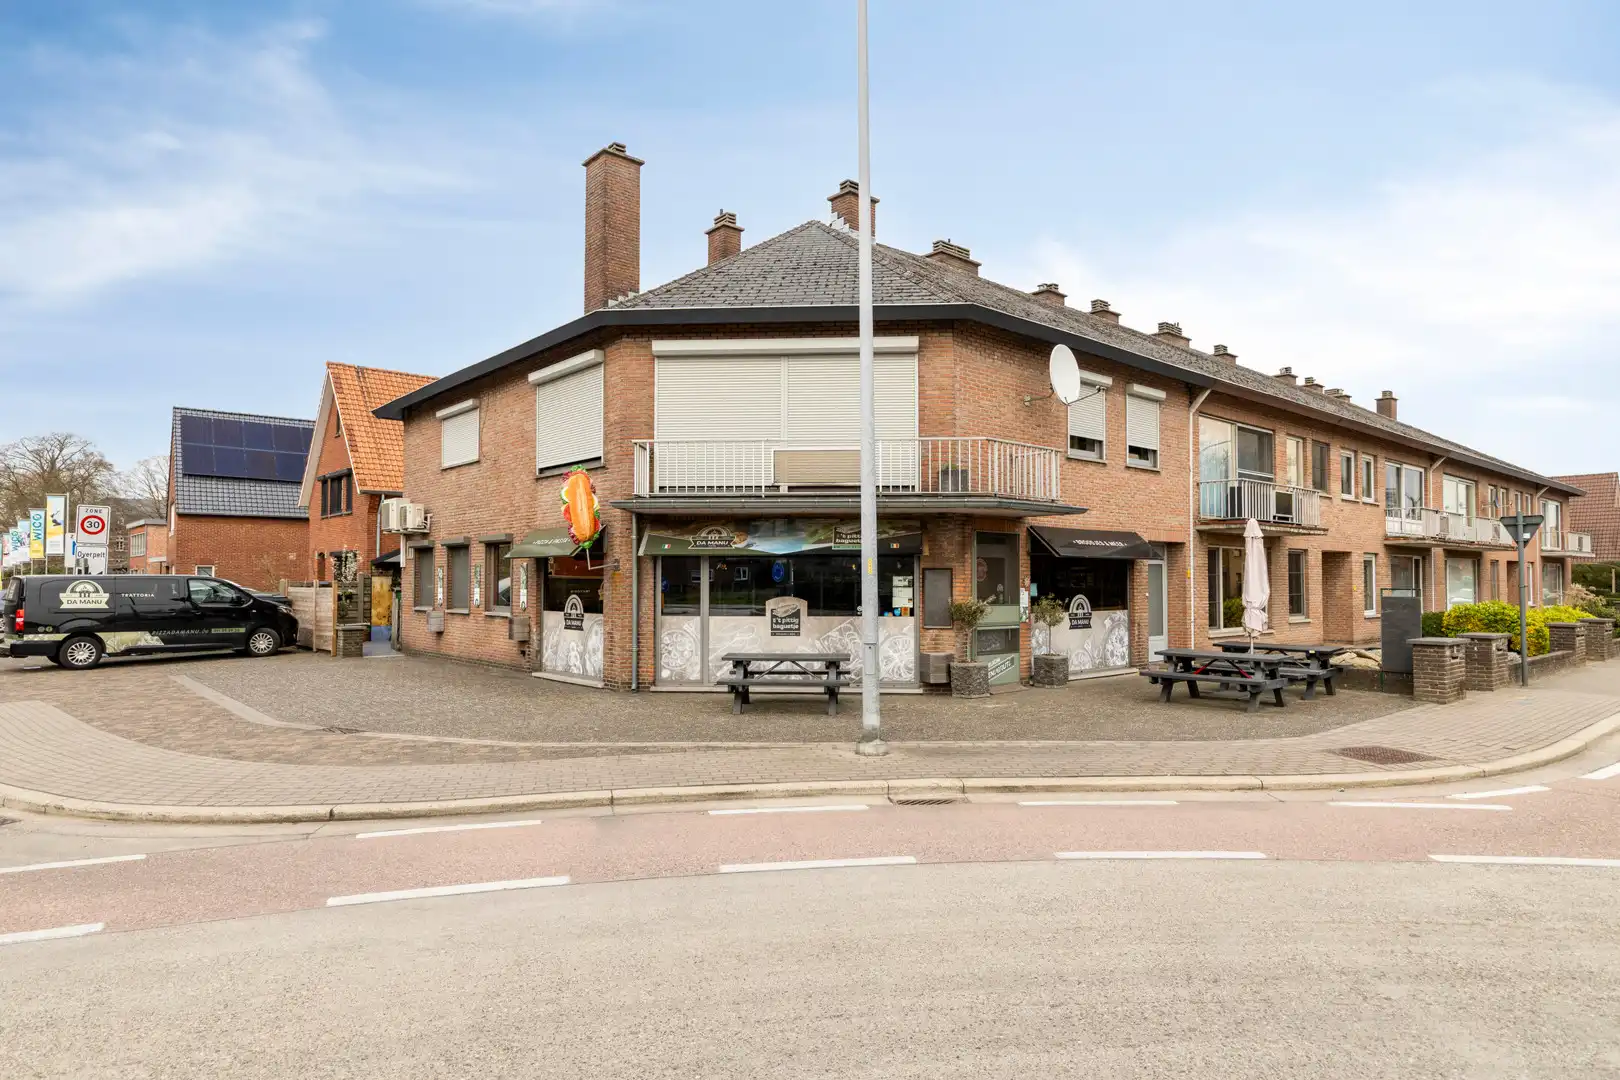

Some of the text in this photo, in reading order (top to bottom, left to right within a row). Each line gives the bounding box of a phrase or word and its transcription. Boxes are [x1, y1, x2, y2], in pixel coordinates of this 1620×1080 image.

[32, 513, 42, 541] WICO
[86, 520, 100, 529] 30
[77, 550, 106, 559] Overpelt
[772, 623, 799, 631] baguetje
